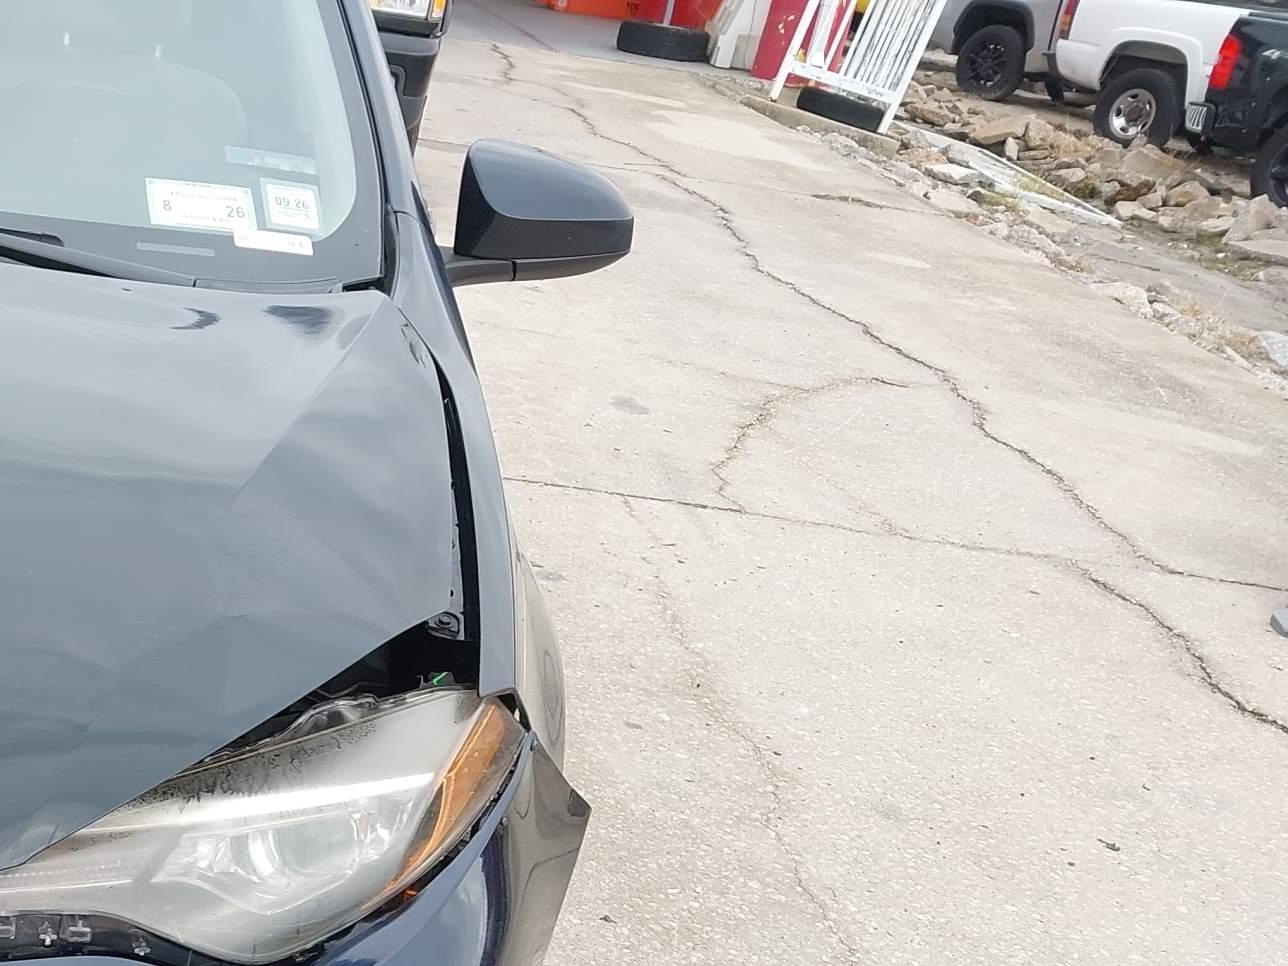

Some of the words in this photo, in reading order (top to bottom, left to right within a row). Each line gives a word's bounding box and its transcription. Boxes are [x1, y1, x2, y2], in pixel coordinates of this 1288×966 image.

[162, 199, 172, 211] 8
[225, 205, 245, 218] 26
[274, 195, 289, 207] 09
[294, 198, 309, 209] 26
